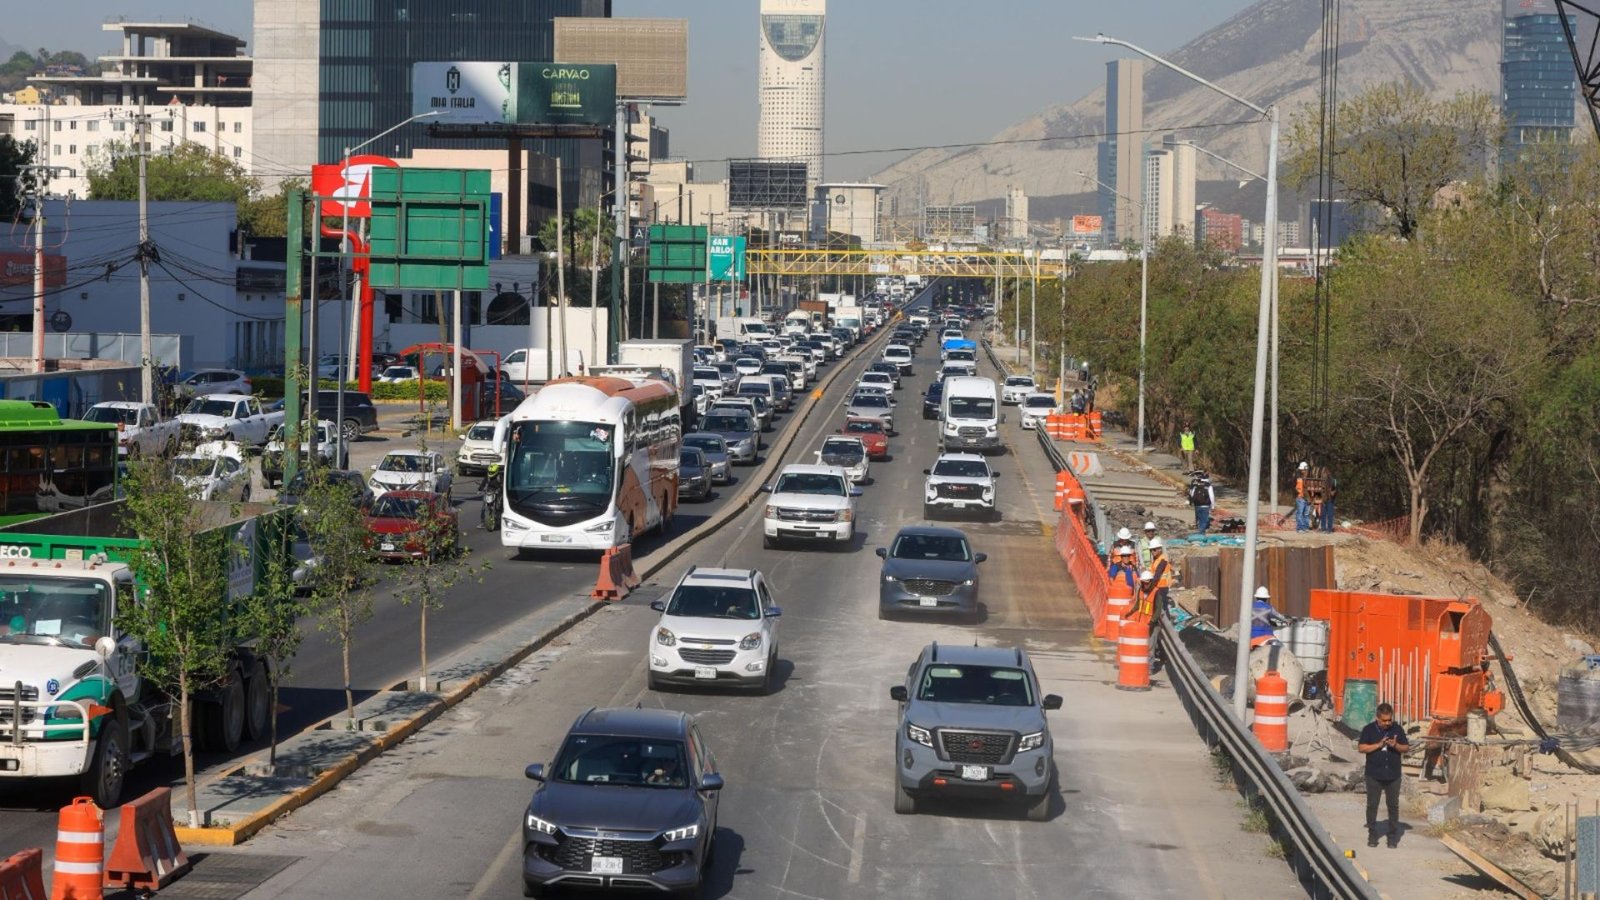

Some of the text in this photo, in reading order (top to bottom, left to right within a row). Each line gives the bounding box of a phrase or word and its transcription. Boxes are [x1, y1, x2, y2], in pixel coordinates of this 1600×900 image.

[542, 68, 590, 80] CARVAO
[431, 97, 475, 108] MIA ITALIA
[712, 238, 729, 246] SAN
[0, 545, 31, 559] ECO
